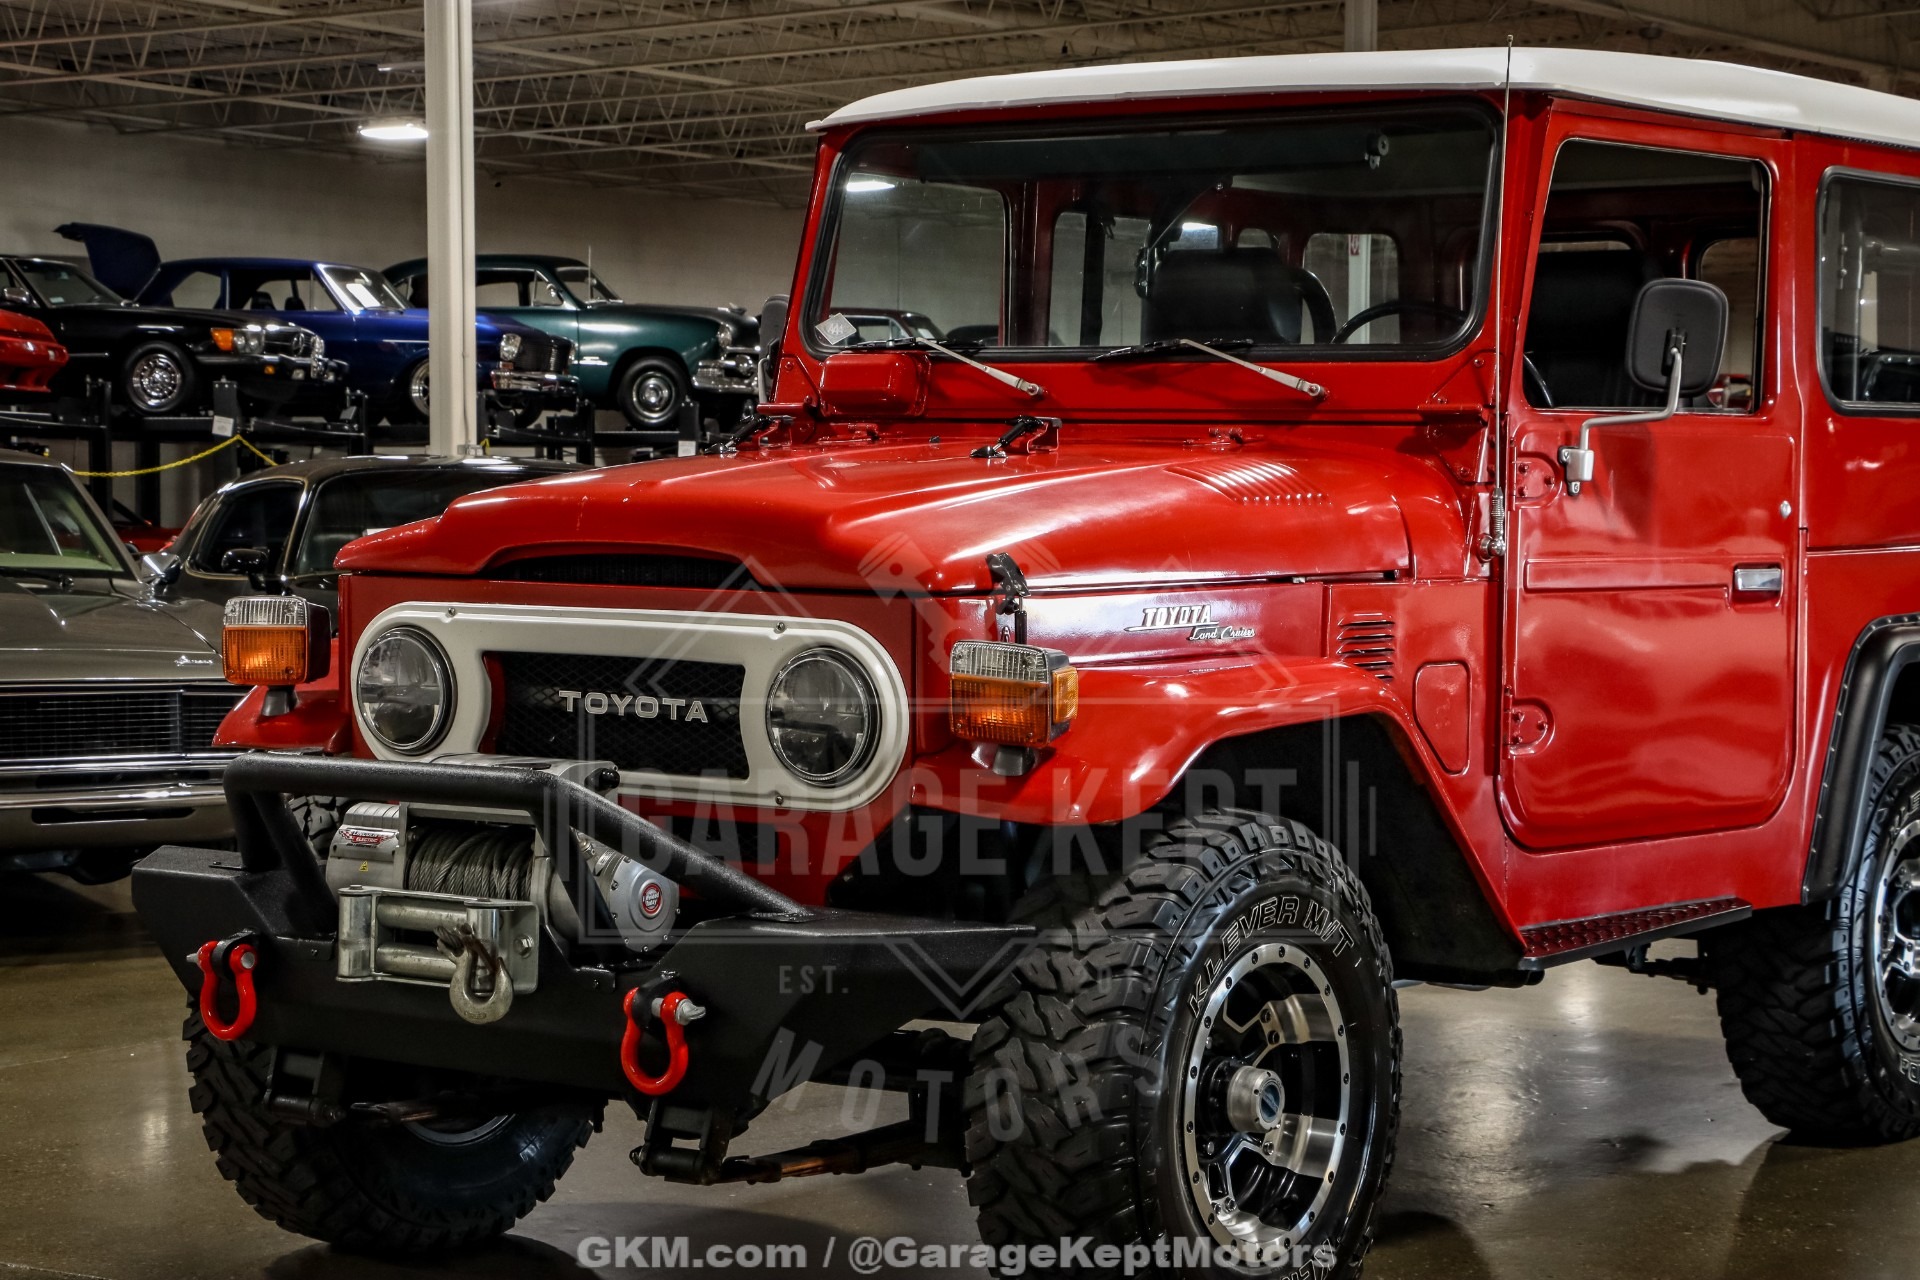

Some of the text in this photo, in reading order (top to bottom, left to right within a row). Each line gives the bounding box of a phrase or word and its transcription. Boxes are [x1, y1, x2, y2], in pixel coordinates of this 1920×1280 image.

[1142, 605, 1212, 628] TOYOTA
[1188, 627, 1218, 641] Land
[558, 690, 709, 723] TOYOTA
[1188, 894, 1300, 1019] KLEVER
